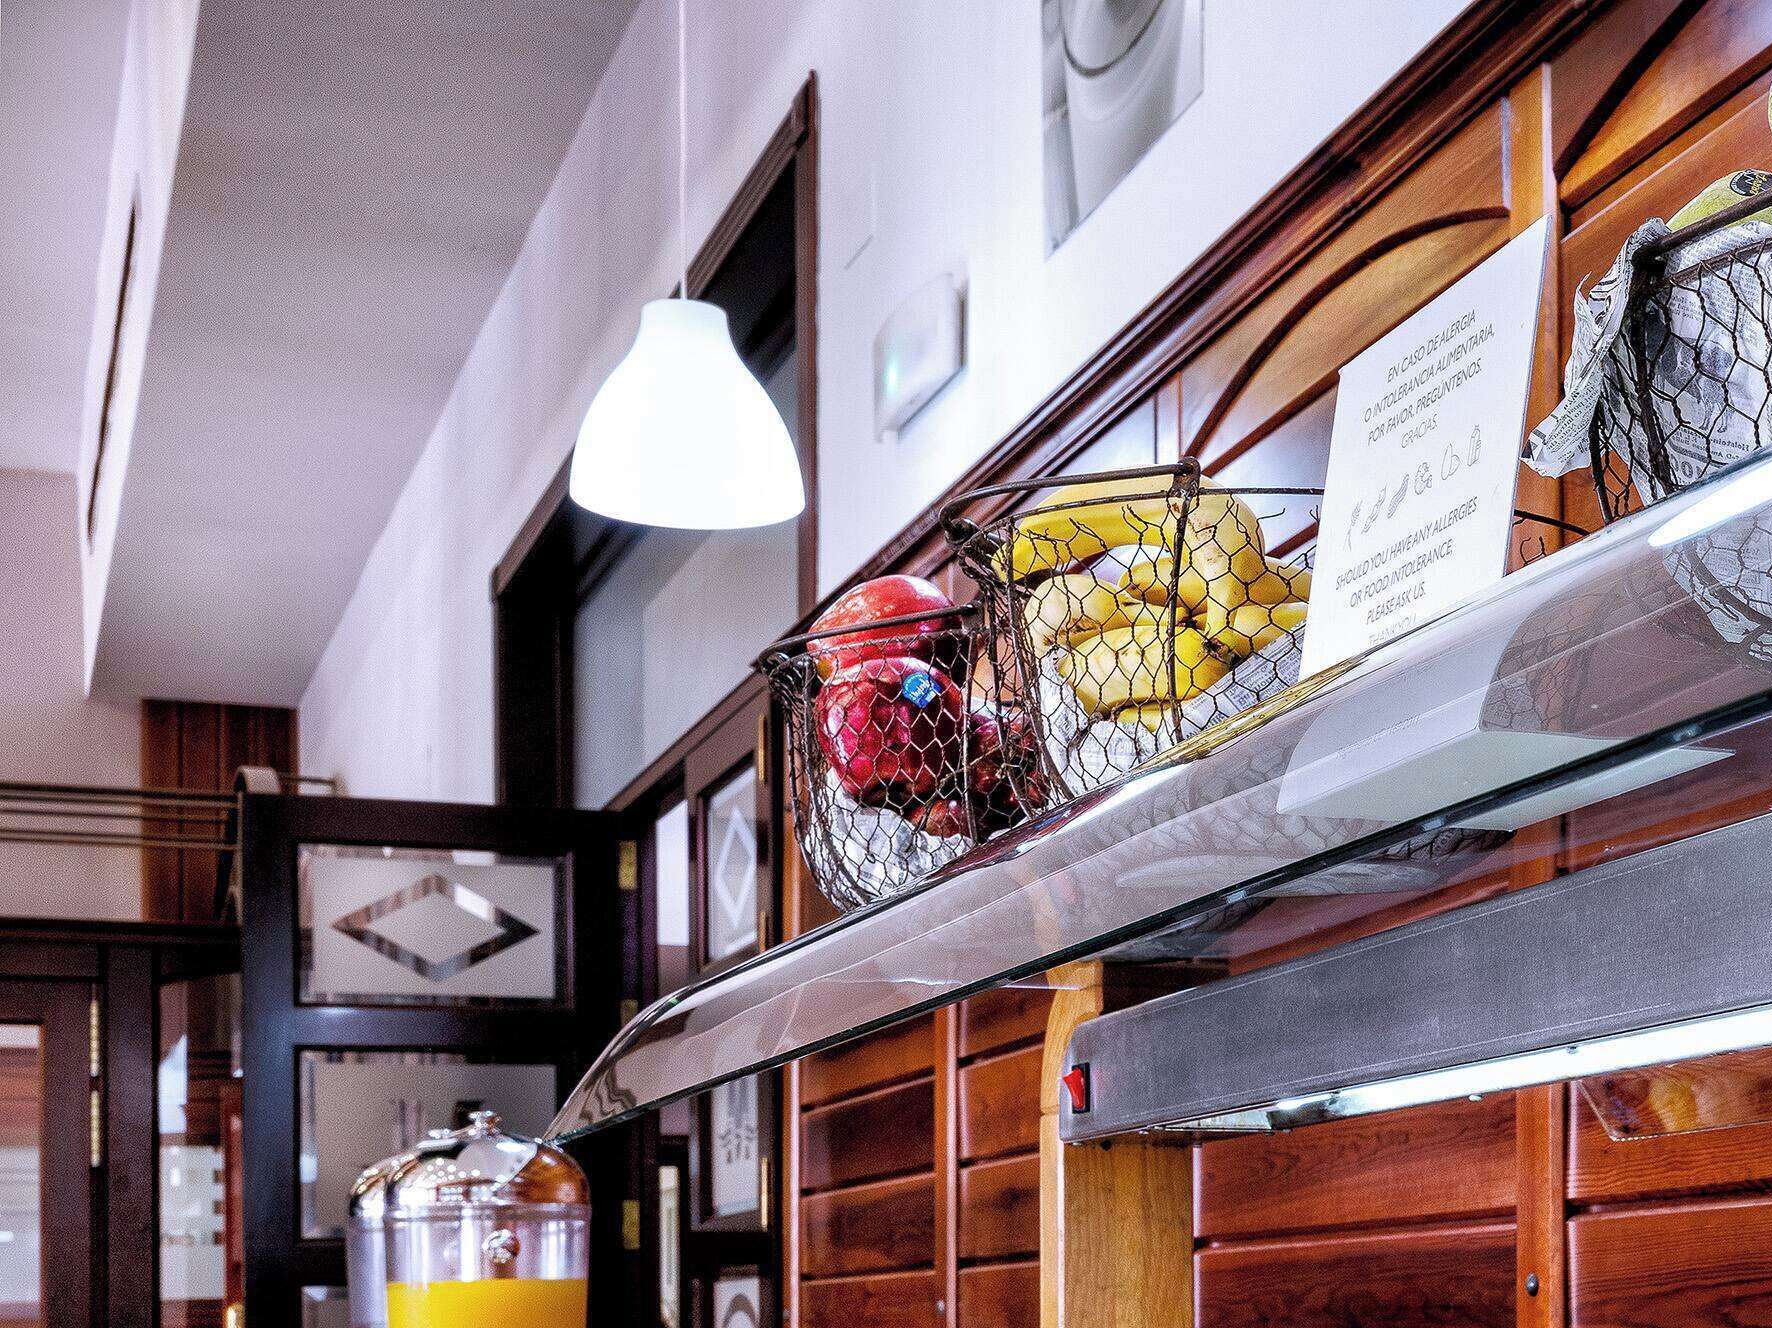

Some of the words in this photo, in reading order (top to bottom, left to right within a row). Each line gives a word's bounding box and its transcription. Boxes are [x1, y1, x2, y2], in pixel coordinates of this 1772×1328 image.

[1387, 362, 1400, 383] EN
[1401, 346, 1426, 373] CASO
[1426, 334, 1440, 356] DE
[1440, 309, 1476, 347] ALERGIA
[1364, 407, 1372, 423] O
[1373, 364, 1435, 418] INTOLERANCIA
[1368, 423, 1385, 446] POR
[1335, 560, 1370, 591] SHOULD
[1371, 548, 1389, 571] YOU
[1390, 534, 1412, 561] HAVE
[1412, 522, 1433, 548] ANY
[1432, 496, 1478, 537] ALLERGIES
[1350, 589, 1363, 608] OR
[1364, 575, 1389, 601] FOOD
[1367, 597, 1395, 625] PLEASE
[1395, 587, 1412, 610] ASK
